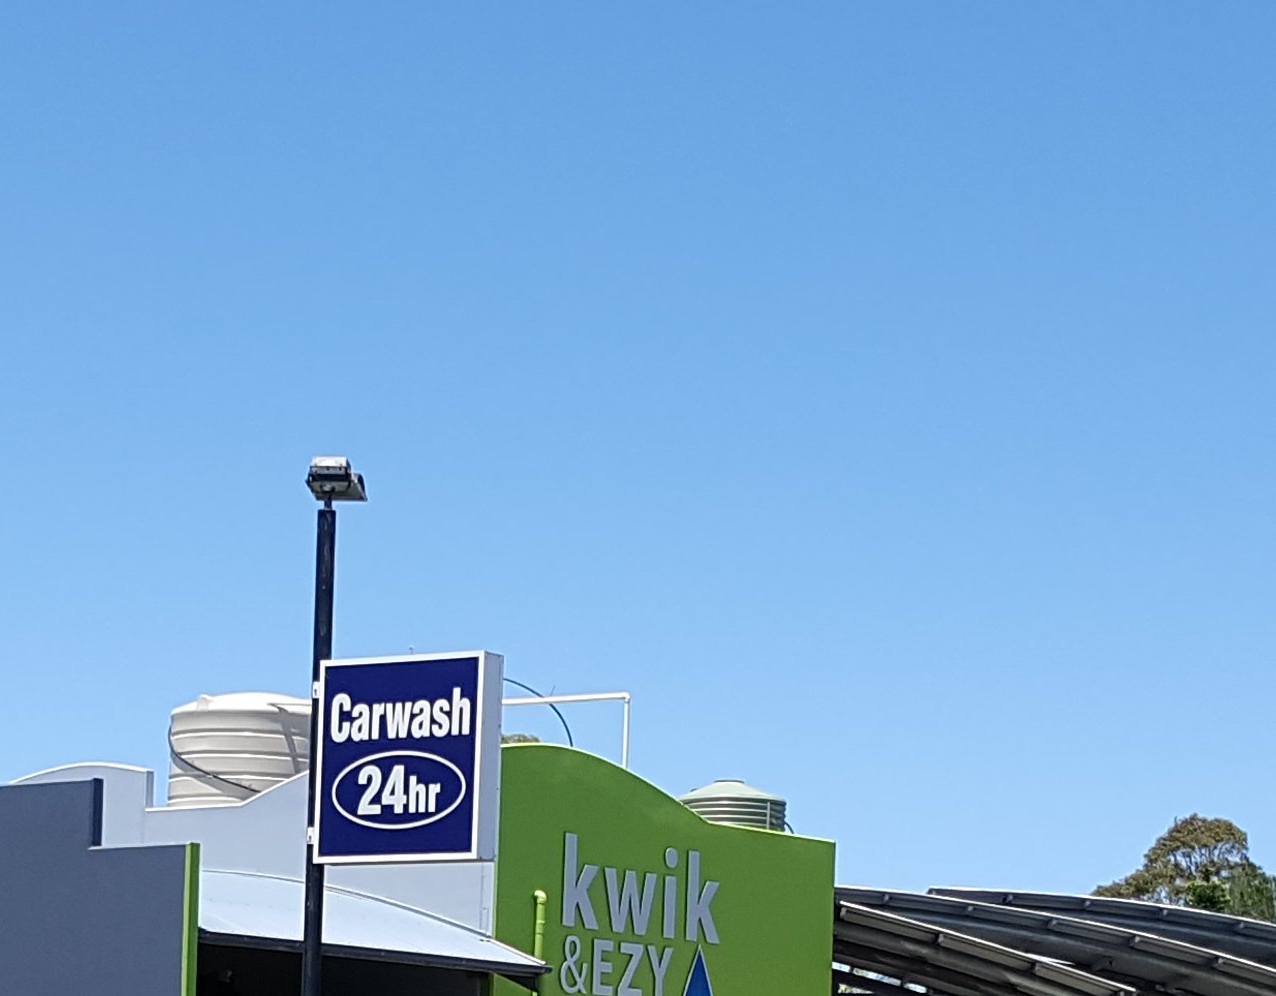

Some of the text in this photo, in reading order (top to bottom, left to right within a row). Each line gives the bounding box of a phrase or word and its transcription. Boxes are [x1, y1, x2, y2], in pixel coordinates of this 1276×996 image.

[330, 687, 471, 743] Carwash
[357, 764, 441, 815] 24hr
[562, 833, 720, 944] kwik
